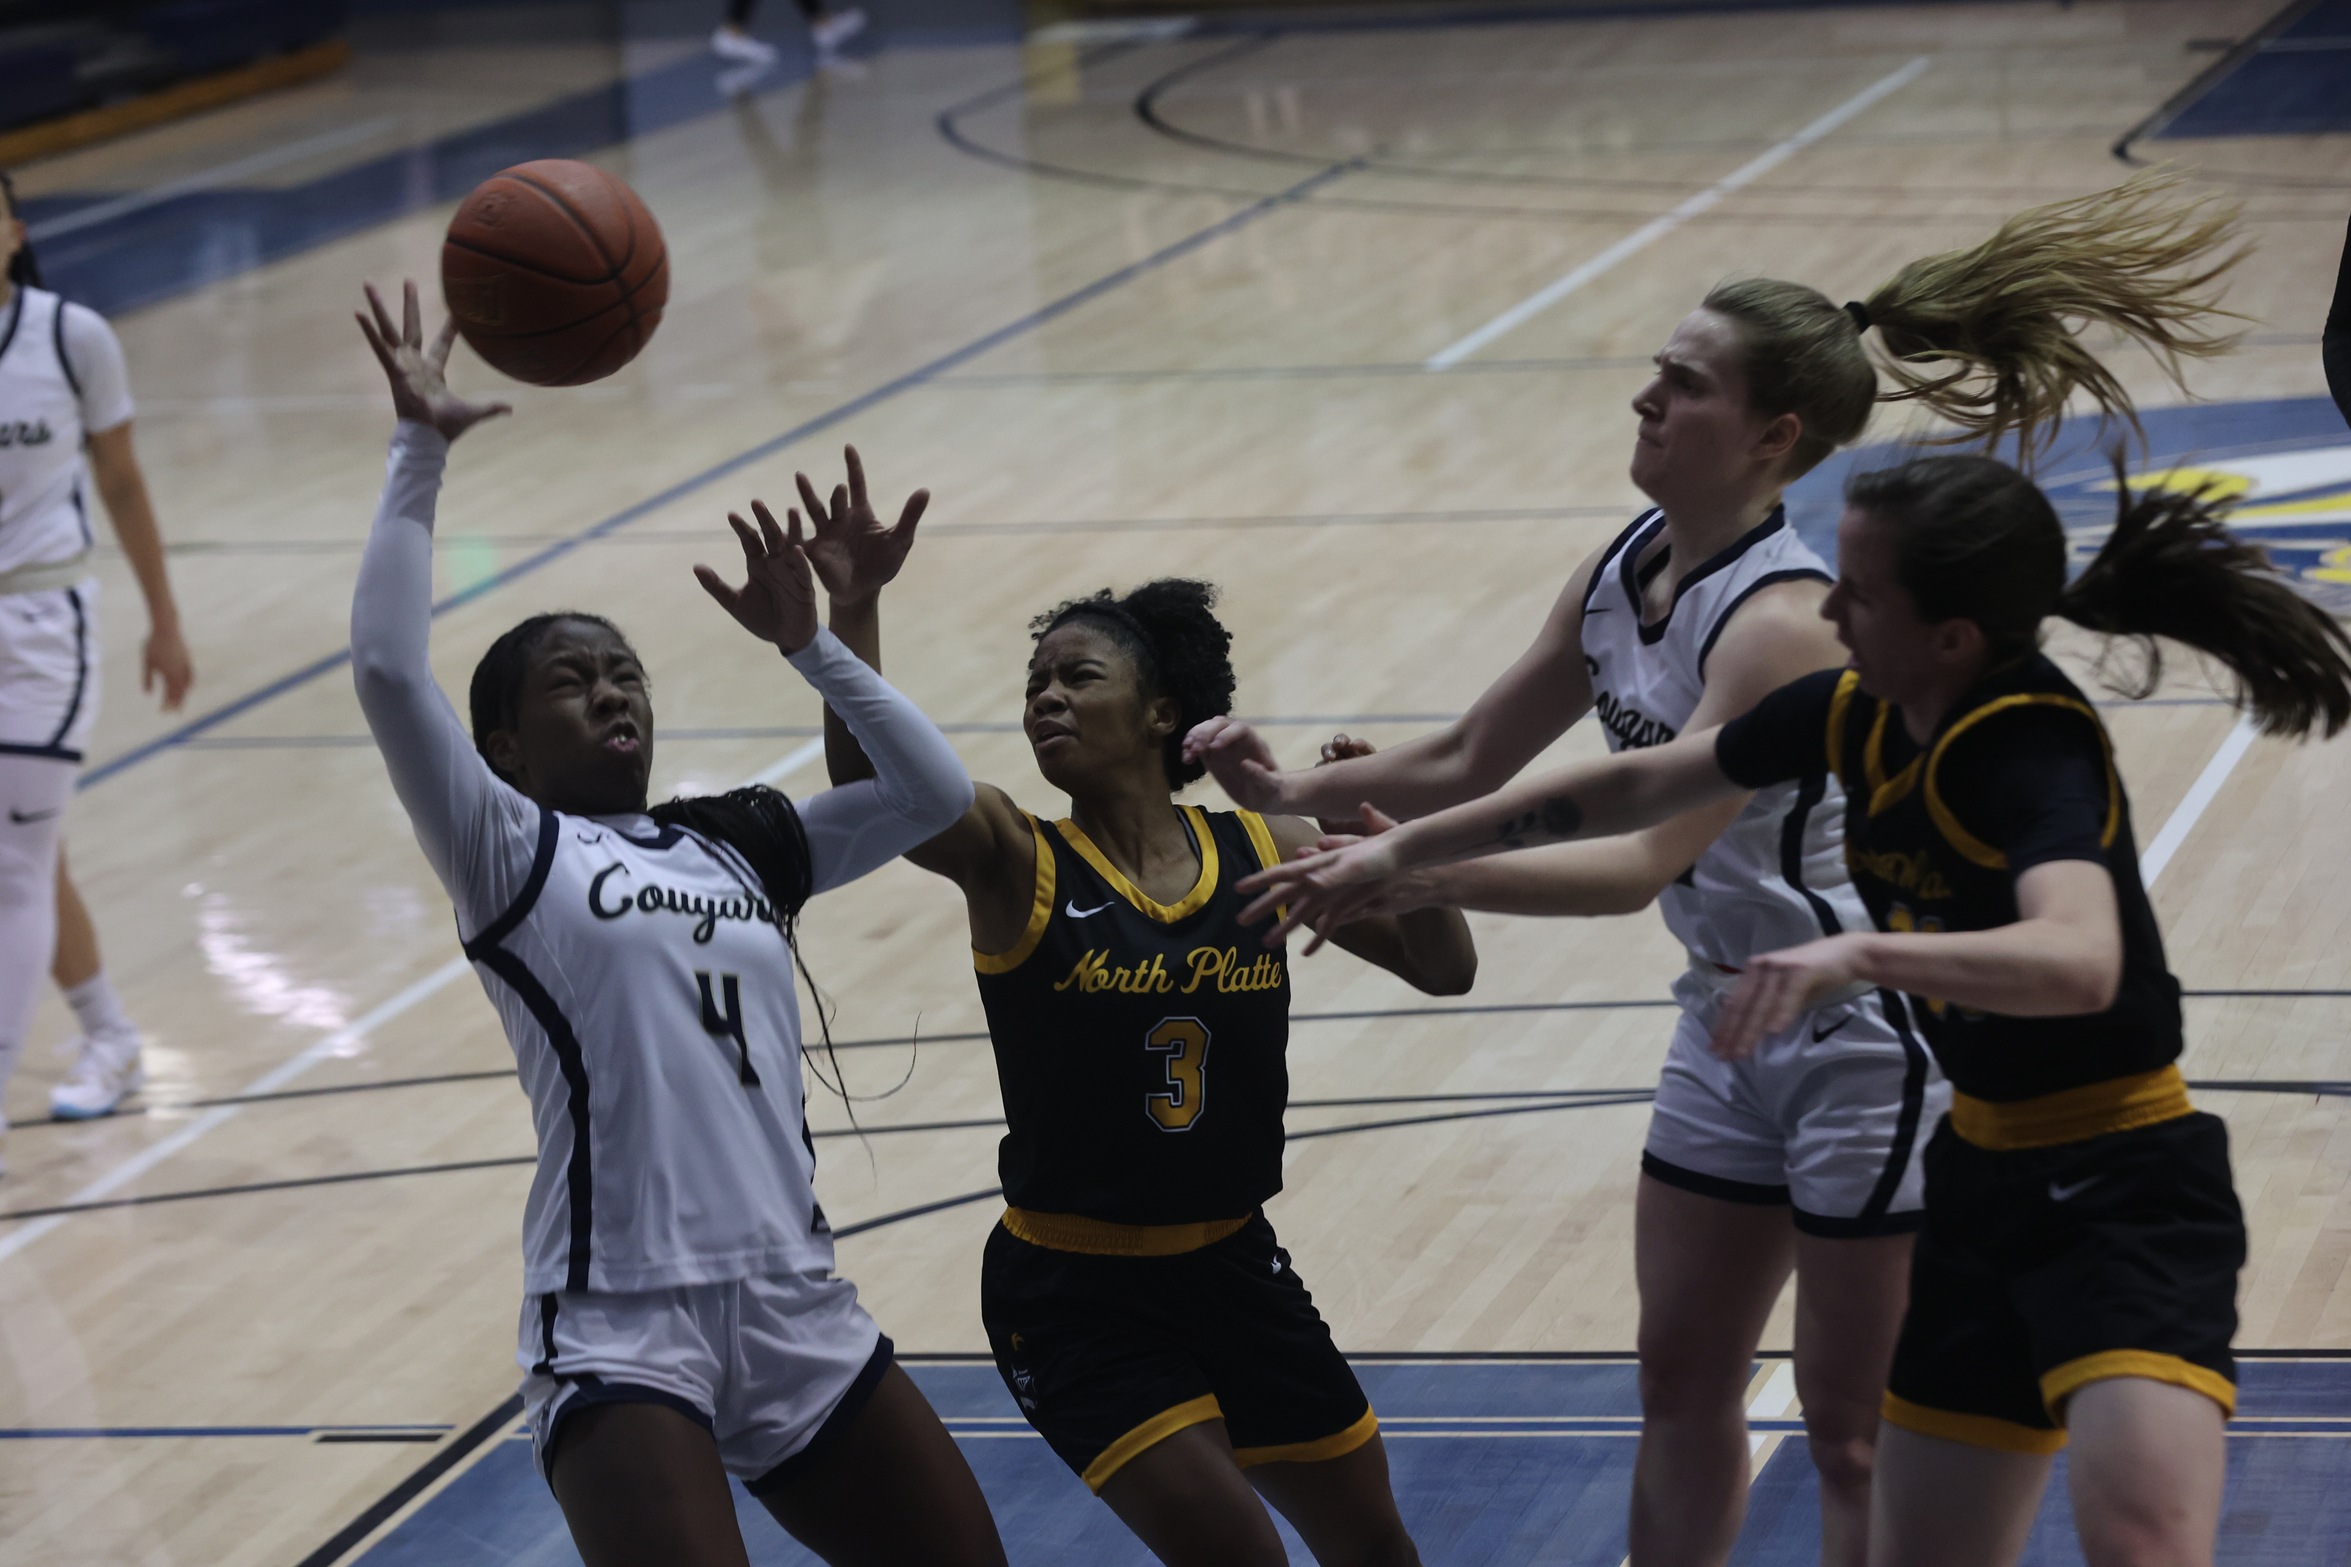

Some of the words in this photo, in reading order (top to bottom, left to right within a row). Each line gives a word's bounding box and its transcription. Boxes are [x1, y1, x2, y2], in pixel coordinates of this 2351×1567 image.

[693, 970, 761, 1088] 4
[1053, 947, 1175, 995] North
[1179, 945, 1283, 995] Platte
[1144, 1015, 1212, 1133] 3
